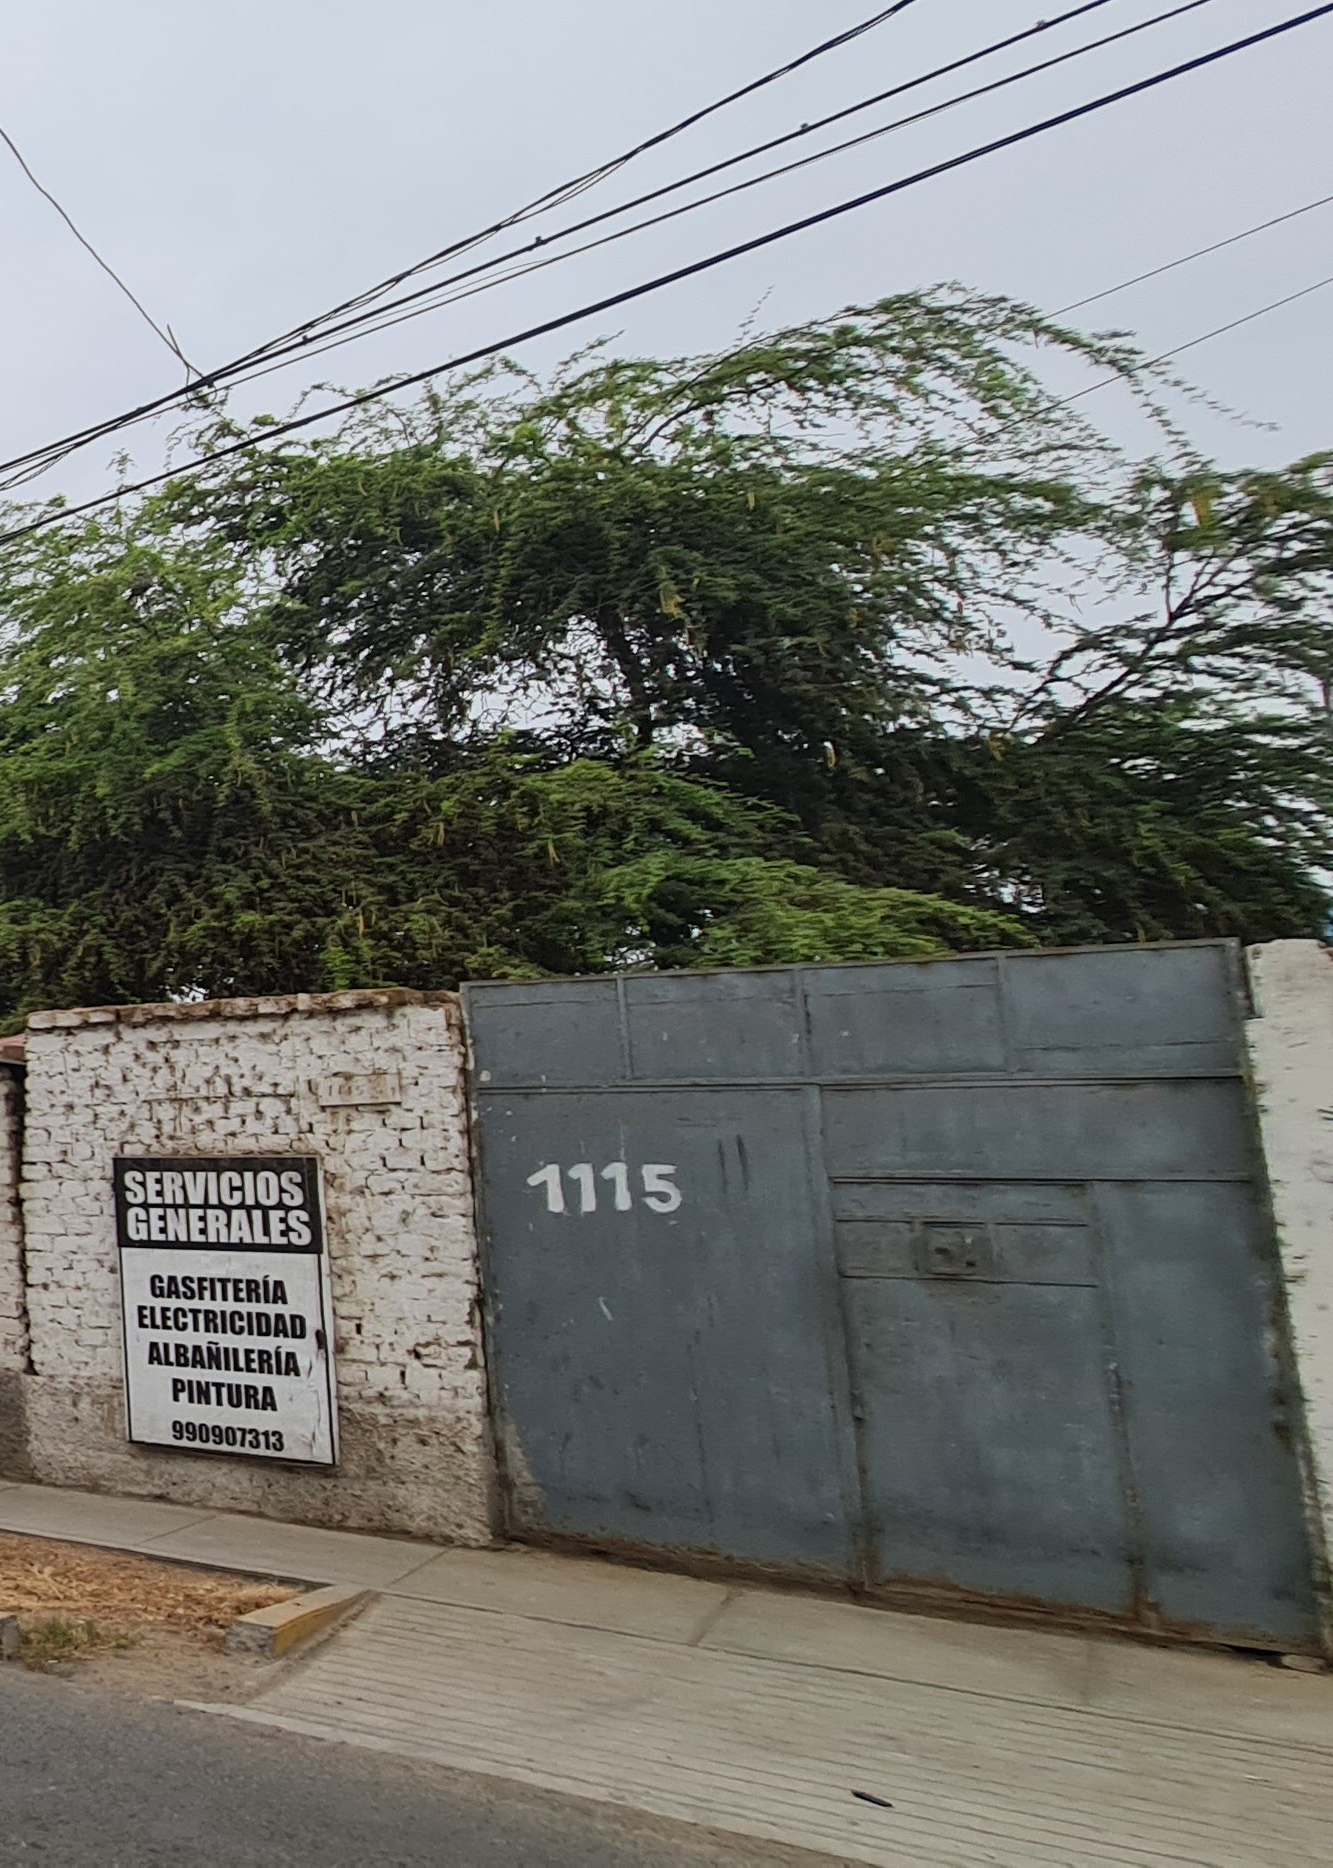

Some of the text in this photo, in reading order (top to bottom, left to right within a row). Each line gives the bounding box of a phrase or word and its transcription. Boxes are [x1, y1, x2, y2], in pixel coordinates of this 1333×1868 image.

[124, 1171, 305, 1207] SERVICIOS
[526, 1162, 682, 1213] 1115
[127, 1207, 313, 1246] GENERALES
[149, 1274, 288, 1305] GASFITERÍA
[137, 1305, 307, 1339] ELECTRICIDAD
[148, 1341, 301, 1376] ALBAÑILERÍA
[172, 1378, 278, 1411] PINTURA
[172, 1420, 284, 1451] 990907313
